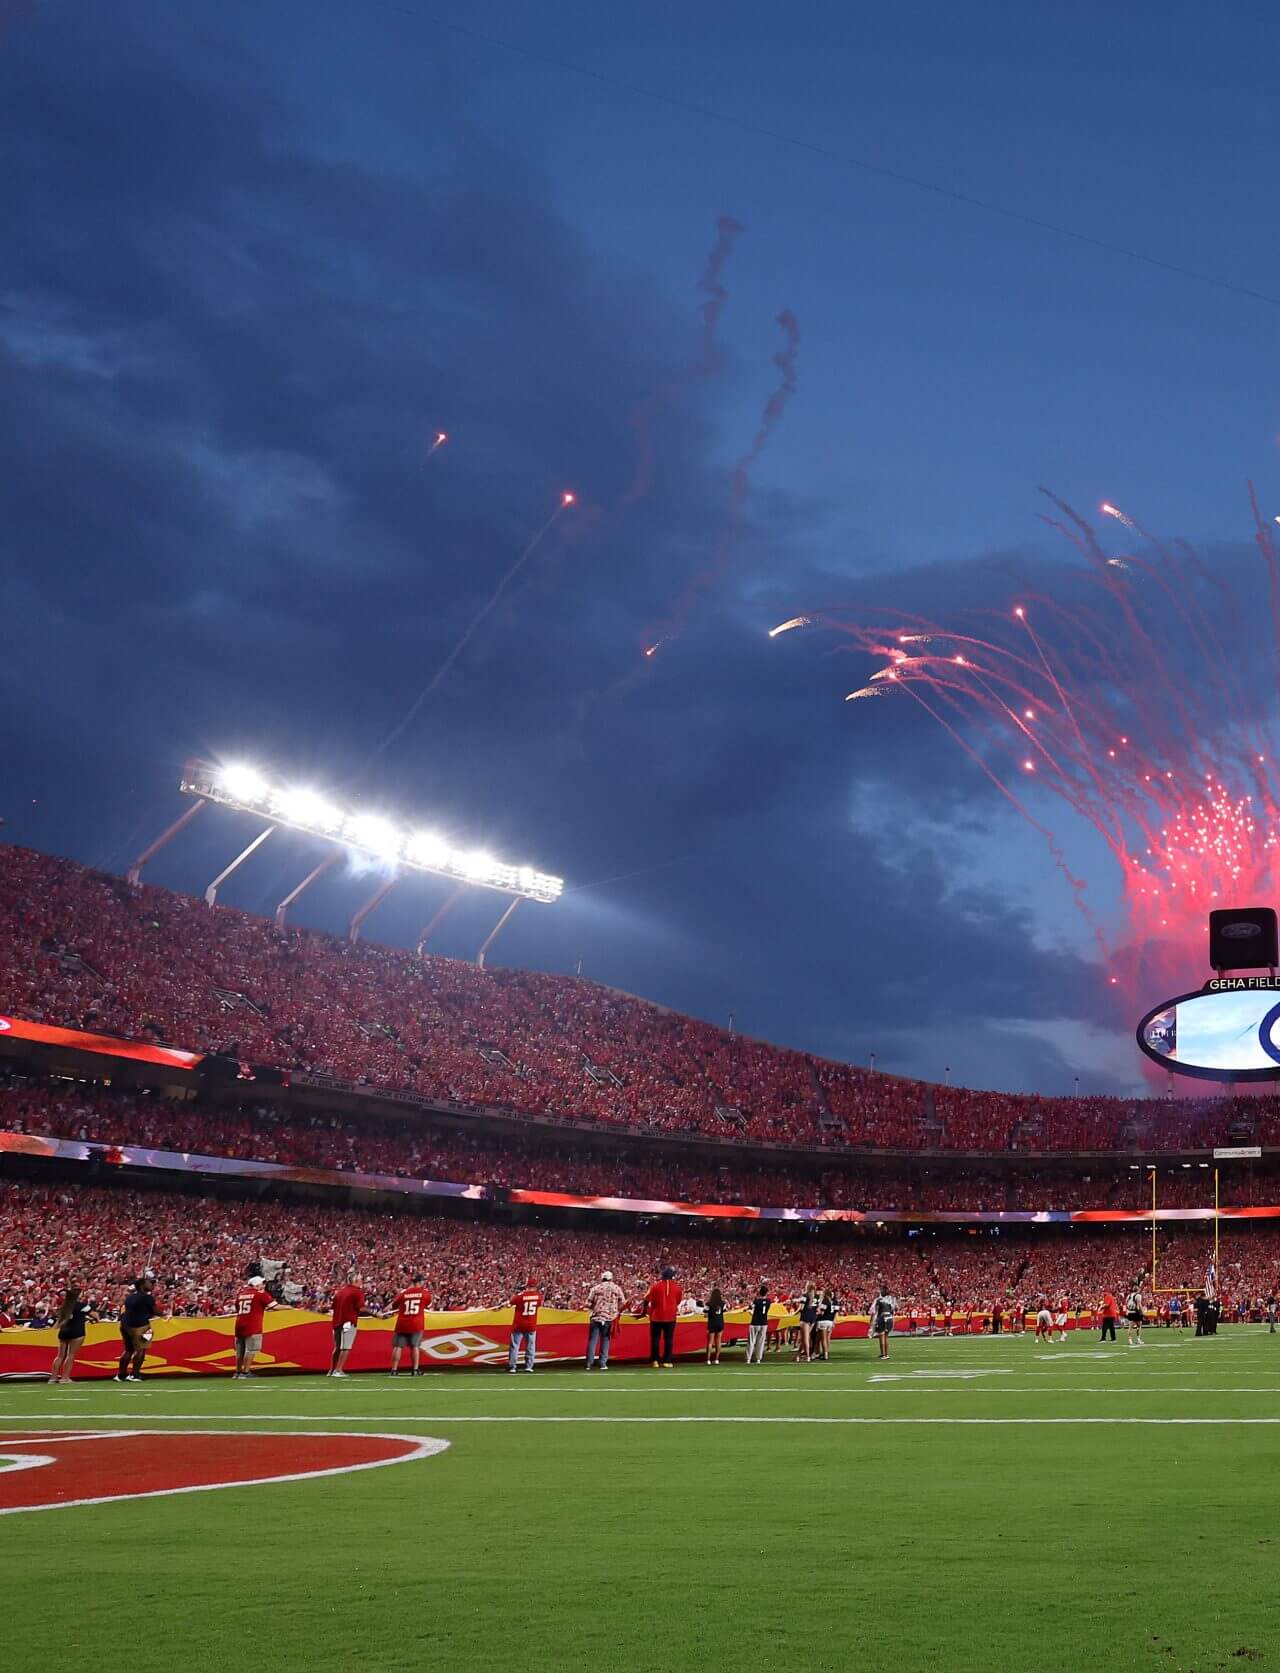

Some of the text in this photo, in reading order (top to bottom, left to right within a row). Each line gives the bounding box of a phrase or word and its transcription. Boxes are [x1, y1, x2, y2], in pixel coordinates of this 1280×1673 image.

[1209, 978, 1246, 990] GEHA
[238, 1300, 252, 1315] 15
[404, 1300, 420, 1315] 15
[522, 1301, 537, 1316] 15
